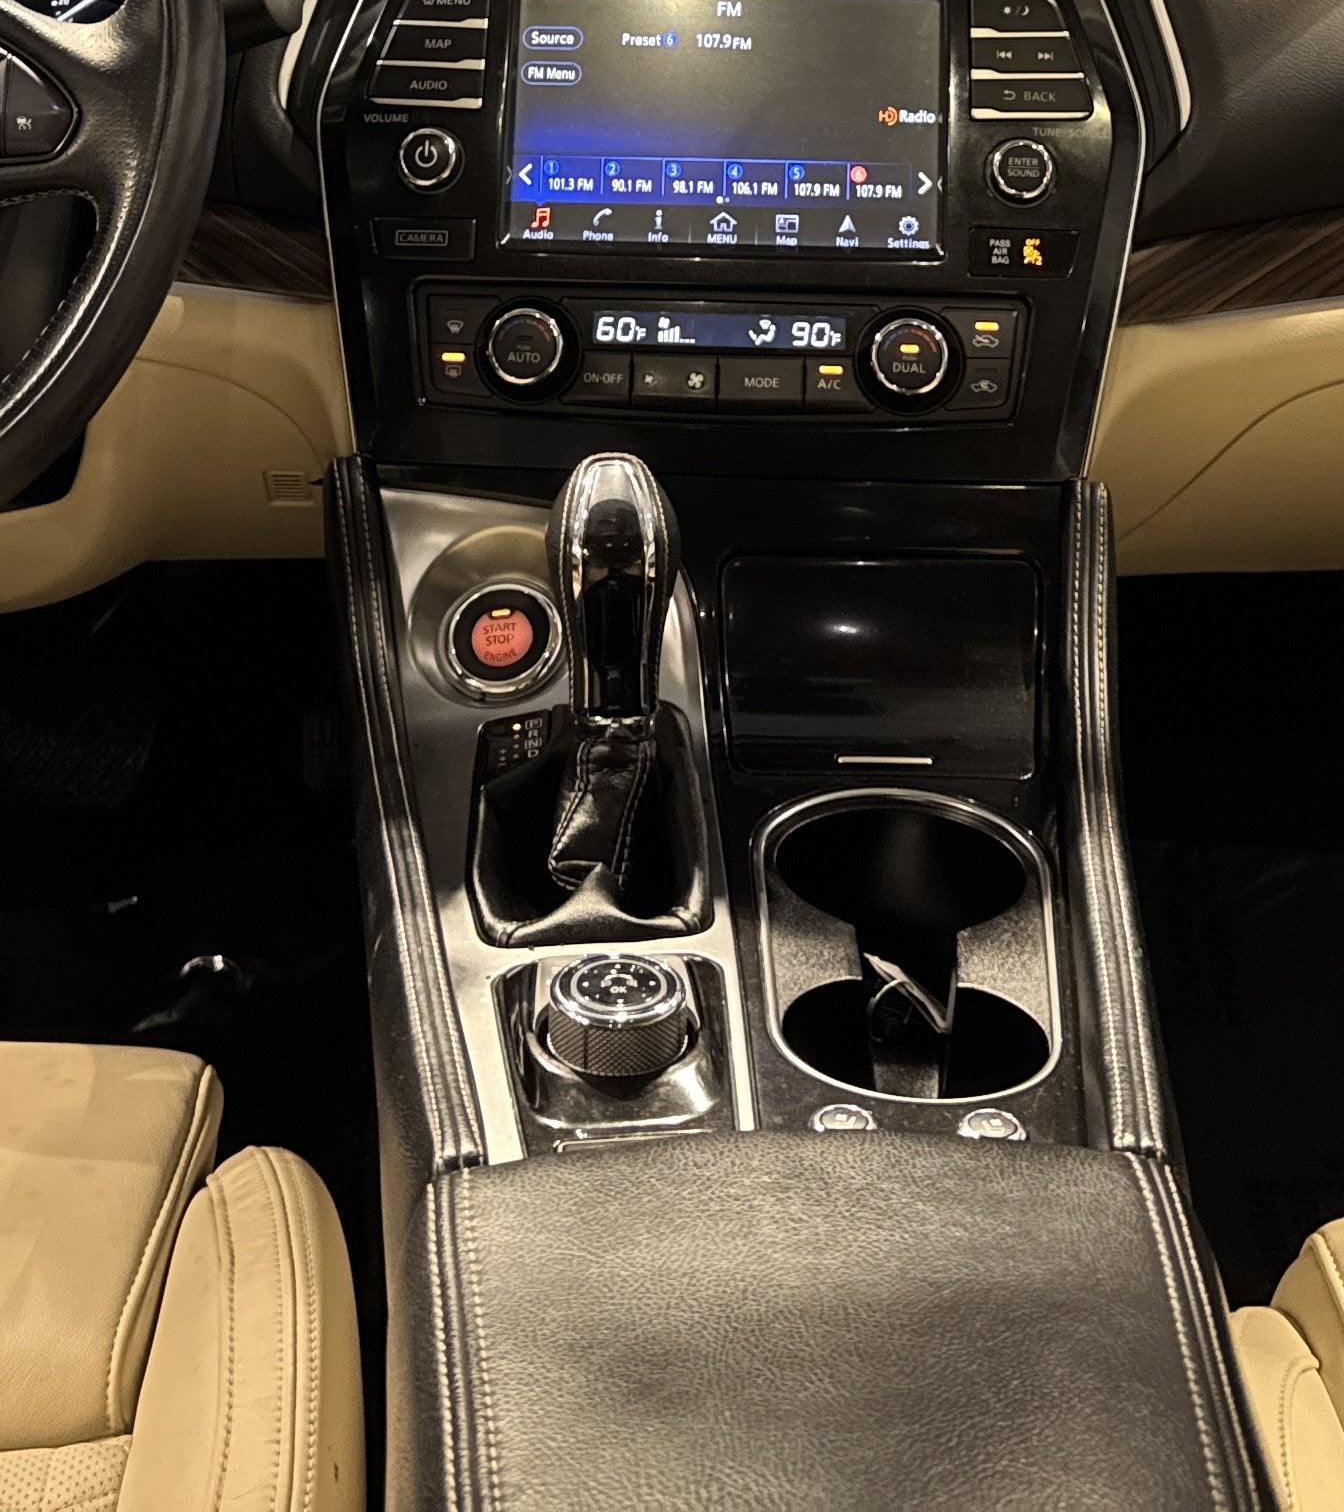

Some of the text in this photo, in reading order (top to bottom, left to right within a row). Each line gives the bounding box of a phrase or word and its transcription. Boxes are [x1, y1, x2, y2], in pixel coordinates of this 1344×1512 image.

[716, 1, 742, 18] FM
[424, 38, 452, 50] MAP
[531, 31, 575, 45] Source
[622, 32, 661, 47] Preset
[527, 66, 576, 81] FM Menu
[409, 80, 448, 90] AUDIO
[1023, 90, 1057, 102] BACK
[363, 112, 409, 123] VOLUME
[898, 109, 937, 124] Radio
[1008, 157, 1039, 166] ENTER
[1007, 168, 1040, 178] SOUND
[547, 177, 594, 192] 101.3 FM
[611, 179, 652, 193] 90.1 FM
[672, 180, 714, 194] 98.1 FM
[731, 181, 778, 196] 106.1 FM
[793, 183, 840, 197] 107.9 FM
[856, 184, 903, 199] 107.9 FM
[399, 232, 445, 244] CAMERA
[522, 229, 555, 240] Audio
[582, 230, 614, 242] Phone
[647, 231, 669, 243] Info
[706, 233, 738, 245] MENU
[775, 235, 798, 247] Map
[835, 236, 859, 248] Navi
[887, 237, 931, 249] Settings
[989, 238, 1012, 249] PASS
[1025, 238, 1041, 247] OFF
[992, 247, 1008, 256] AIR
[991, 255, 1010, 265] BAG
[506, 352, 541, 364] AUTO
[892, 361, 926, 375] DUAL
[744, 376, 780, 388] MODE
[817, 378, 842, 390] A/C
[482, 622, 517, 636] START
[485, 633, 514, 646] STOP
[484, 648, 519, 663] ENGINE
[527, 748, 540, 759] D
[609, 985, 628, 994] OK
